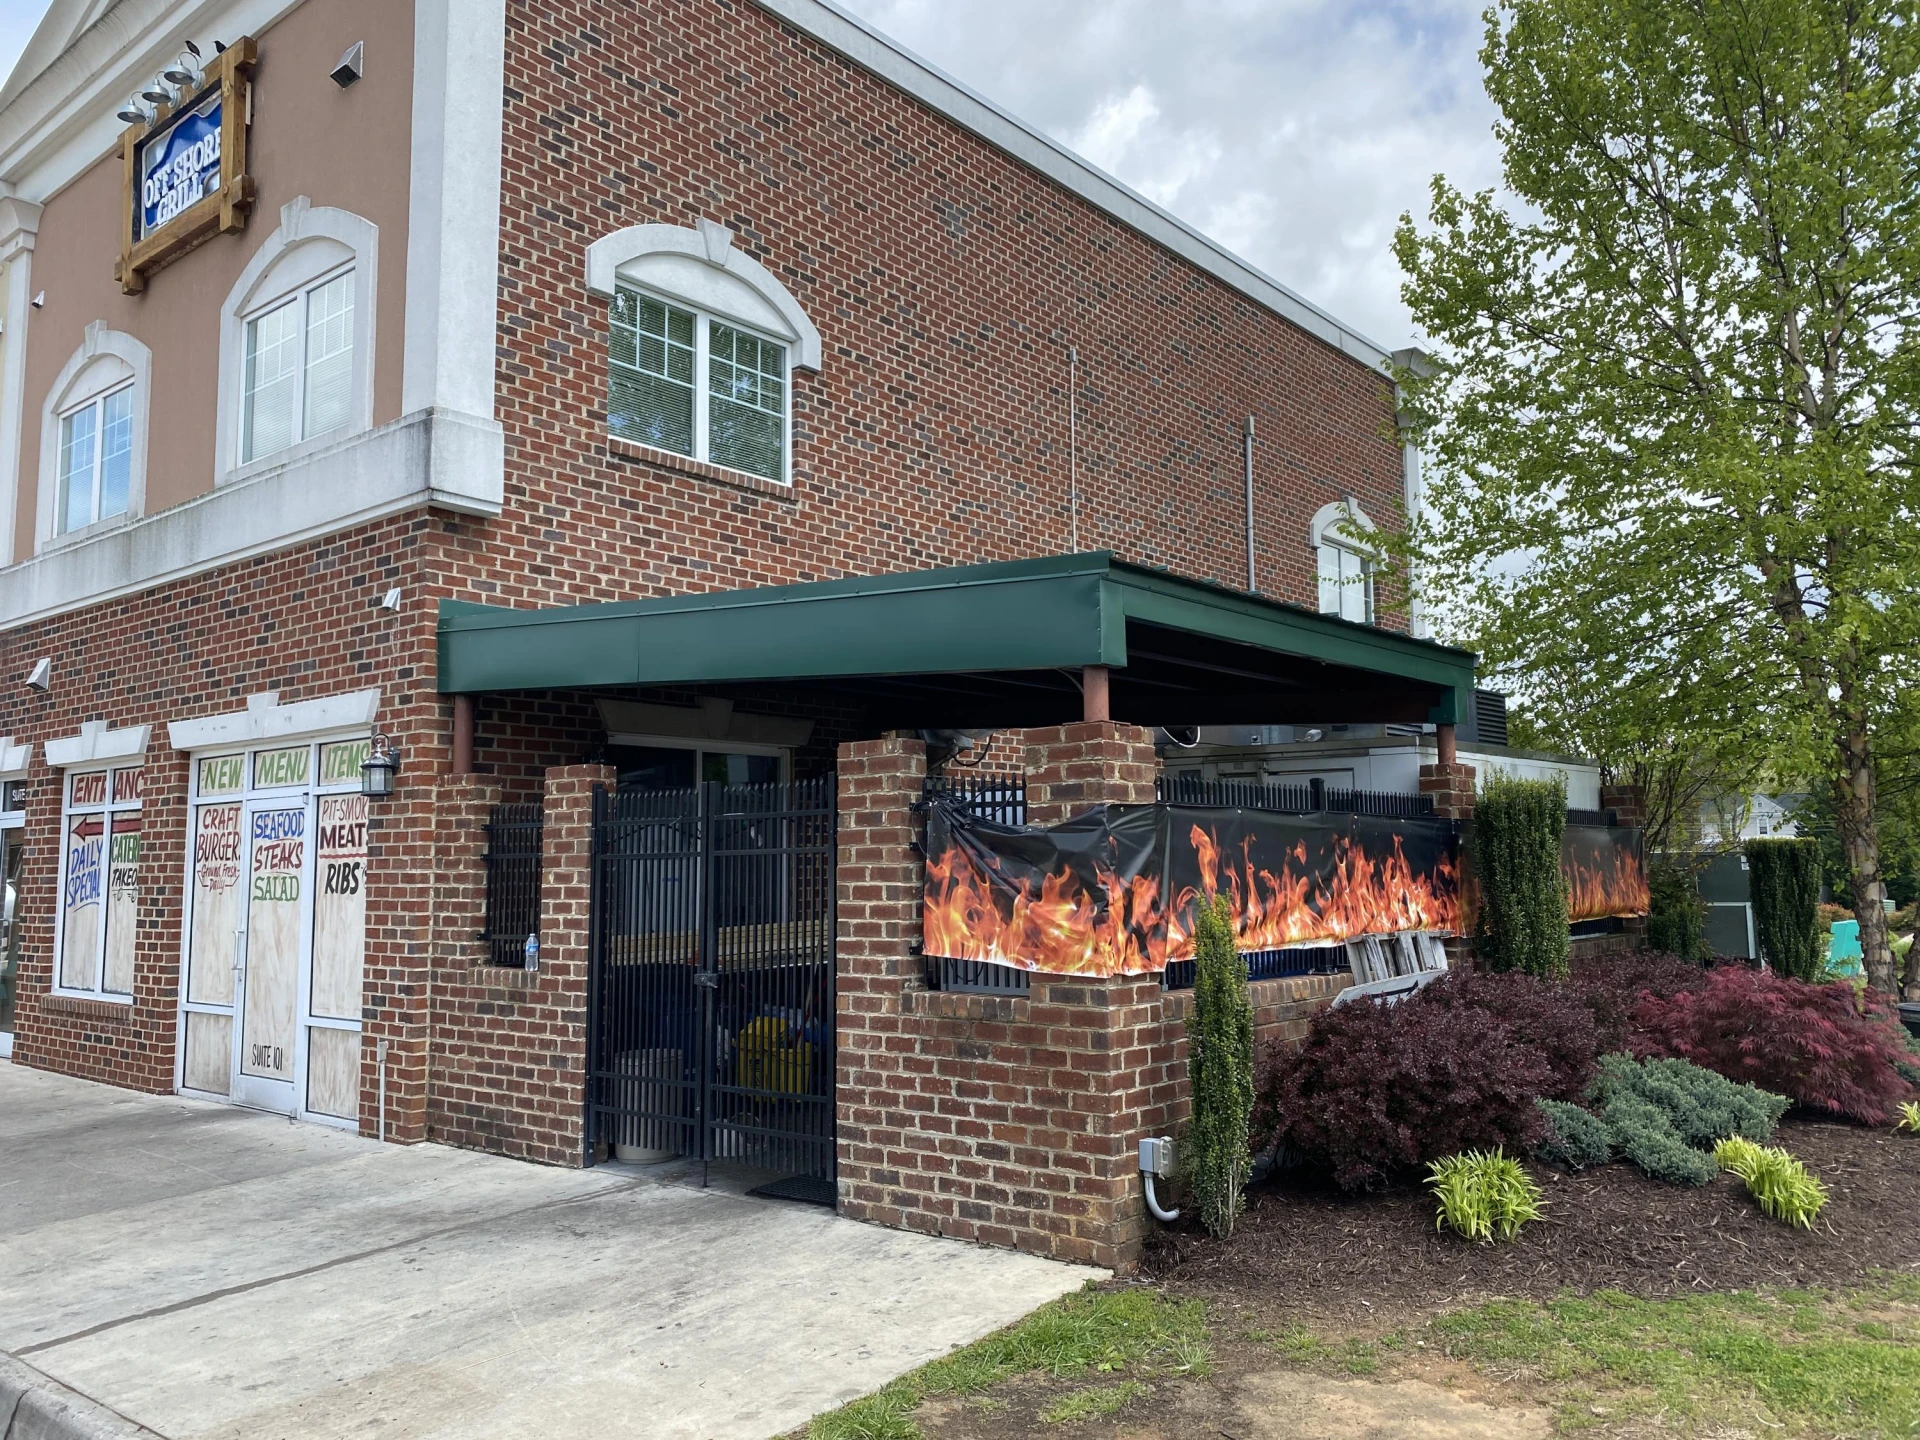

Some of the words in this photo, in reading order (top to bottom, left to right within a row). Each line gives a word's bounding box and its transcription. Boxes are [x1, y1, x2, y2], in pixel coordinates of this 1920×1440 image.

[144, 163, 172, 209] OFF
[156, 172, 203, 225] GRILL
[204, 758, 243, 789] NEW
[257, 750, 309, 784] MENU
[324, 742, 370, 780] ITEMS
[12, 788, 26, 802] SUITE
[203, 807, 241, 831] CRAFT
[254, 811, 305, 840] SEAFOOD
[196, 831, 241, 863] BURGER
[319, 822, 369, 850] MEAT
[71, 838, 103, 876] DAILY
[254, 841, 304, 873] STEAKS
[112, 867, 139, 887] TAKEO
[209, 878, 226, 895] Daily
[252, 876, 301, 902] SALAD
[325, 861, 360, 895] RIBS
[252, 1043, 271, 1068] SUITE
